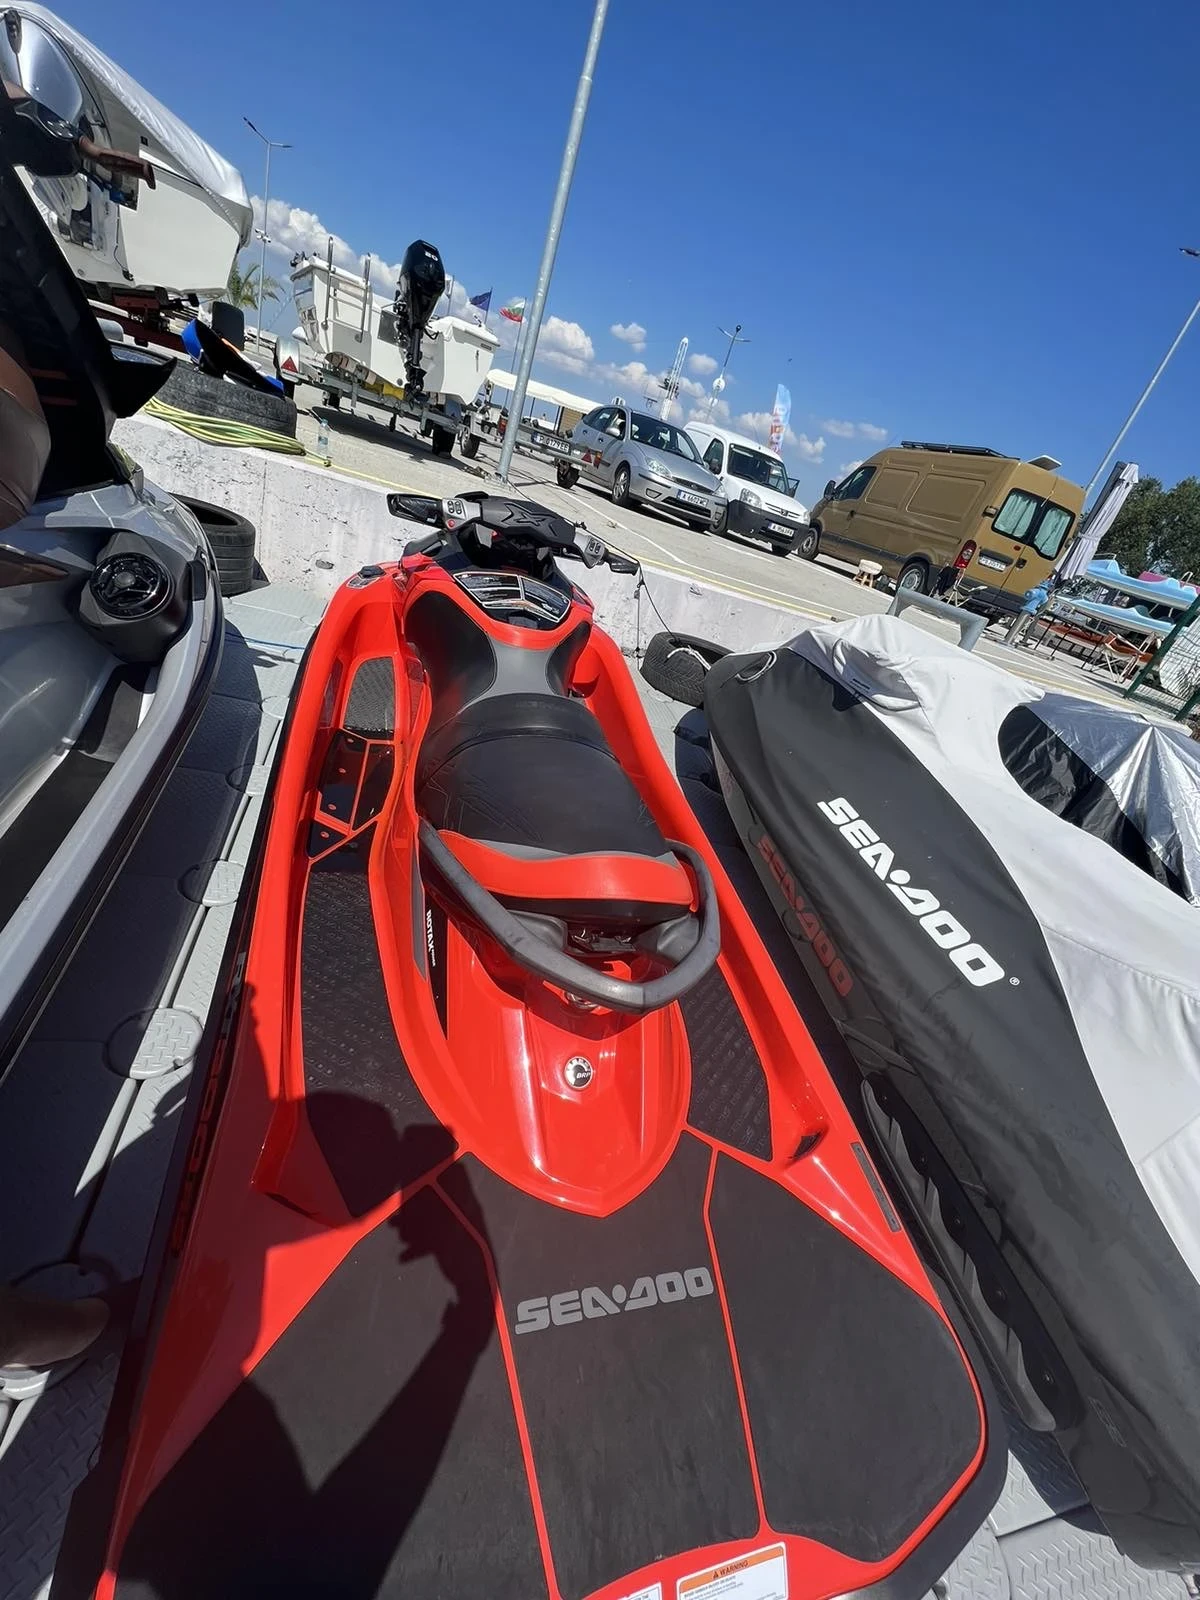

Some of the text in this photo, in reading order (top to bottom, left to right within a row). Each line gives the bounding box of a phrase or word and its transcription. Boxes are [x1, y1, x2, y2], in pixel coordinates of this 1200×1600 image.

[426, 909, 434, 952] ROTAX
[576, 1072, 591, 1080] BRP
[720, 1560, 749, 1577] WARNING
